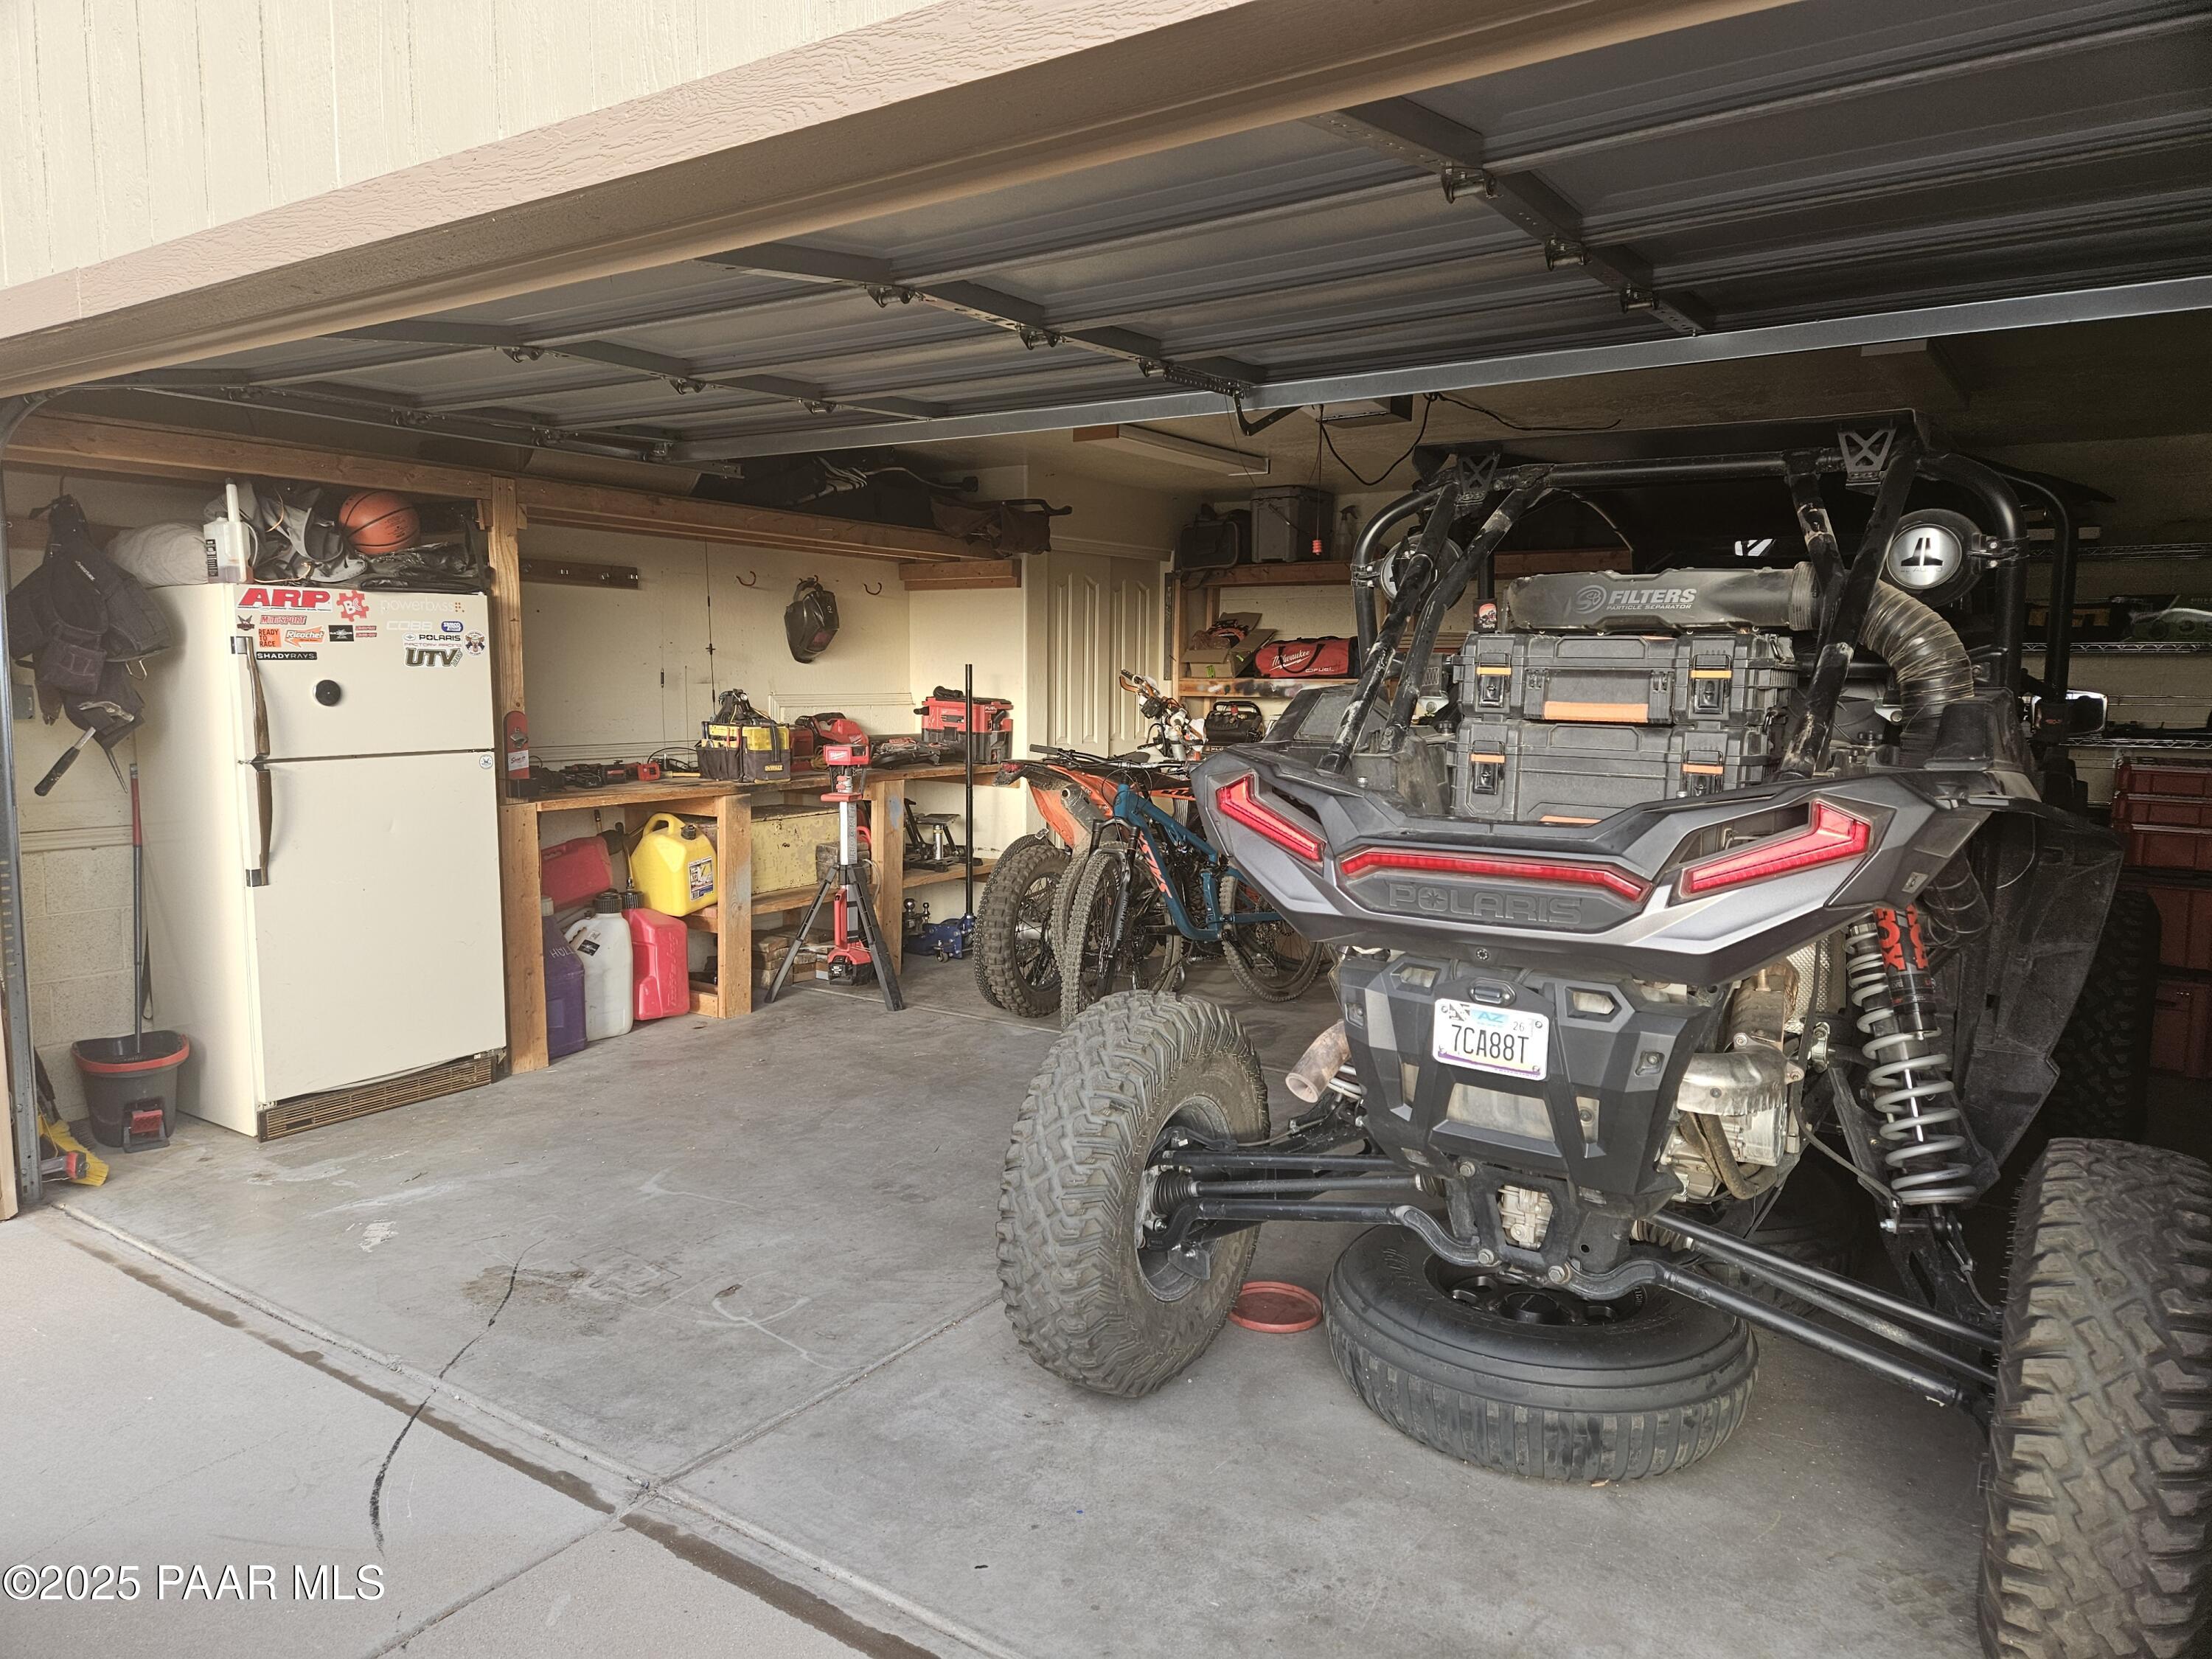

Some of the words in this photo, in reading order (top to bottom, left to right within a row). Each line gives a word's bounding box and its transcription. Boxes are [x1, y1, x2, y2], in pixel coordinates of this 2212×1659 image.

[238, 588, 330, 608] ARP
[1608, 588, 1697, 604] FILTERS
[386, 621, 433, 630] COBB
[286, 630, 324, 639] Ricochet
[405, 647, 459, 667] UTV
[1389, 882, 1582, 925] POLARIS
[1478, 1011, 1503, 1023] AZ
[1512, 1020, 1525, 1032] 26
[1451, 1024, 1529, 1064] 7CA88T
